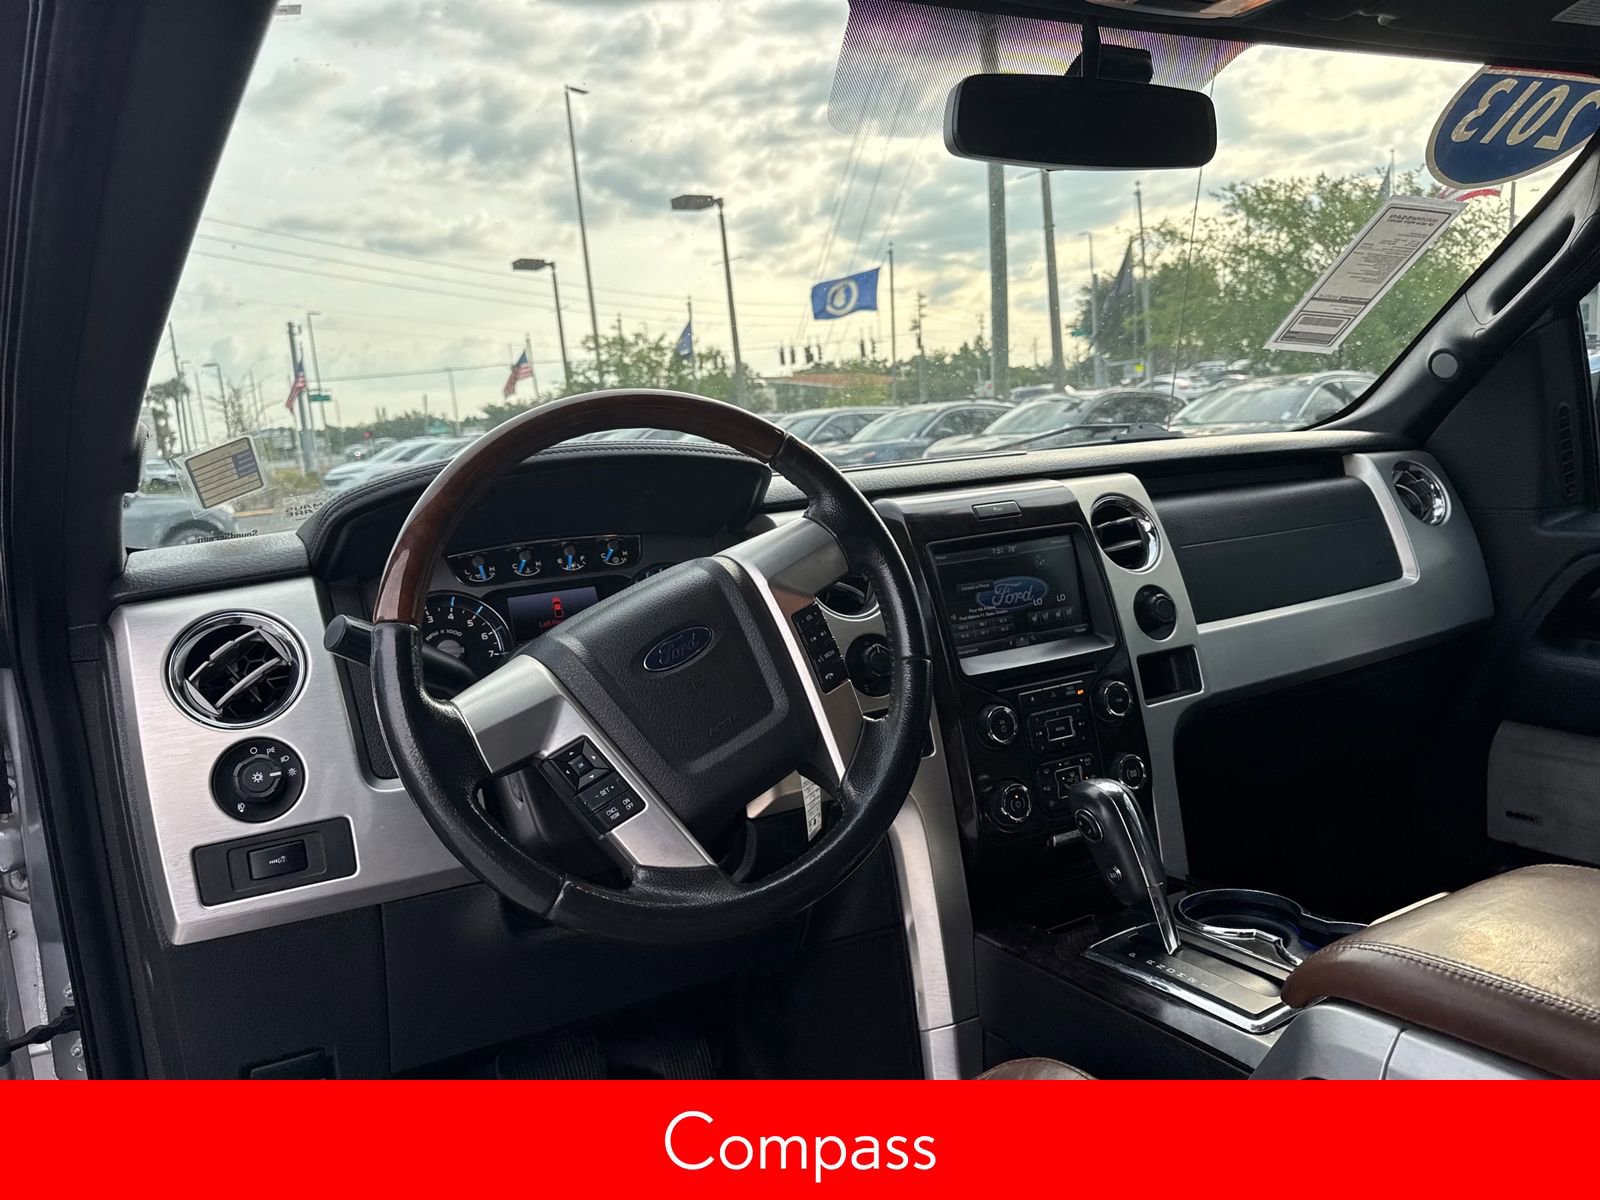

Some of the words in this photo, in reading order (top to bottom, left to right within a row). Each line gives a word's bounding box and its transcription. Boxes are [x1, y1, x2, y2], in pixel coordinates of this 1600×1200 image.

[991, 582, 1034, 606] Ford
[1056, 593, 1066, 602] LO
[1033, 597, 1043, 606] LO
[426, 615, 434, 624] 3
[467, 619, 474, 627] 5
[481, 632, 488, 640] 6
[425, 630, 439, 641] RPM
[446, 629, 463, 637] 1000
[599, 787, 610, 797] SET
[622, 798, 631, 806] ON
[625, 802, 634, 811] OFF
[605, 806, 618, 816] CNCL
